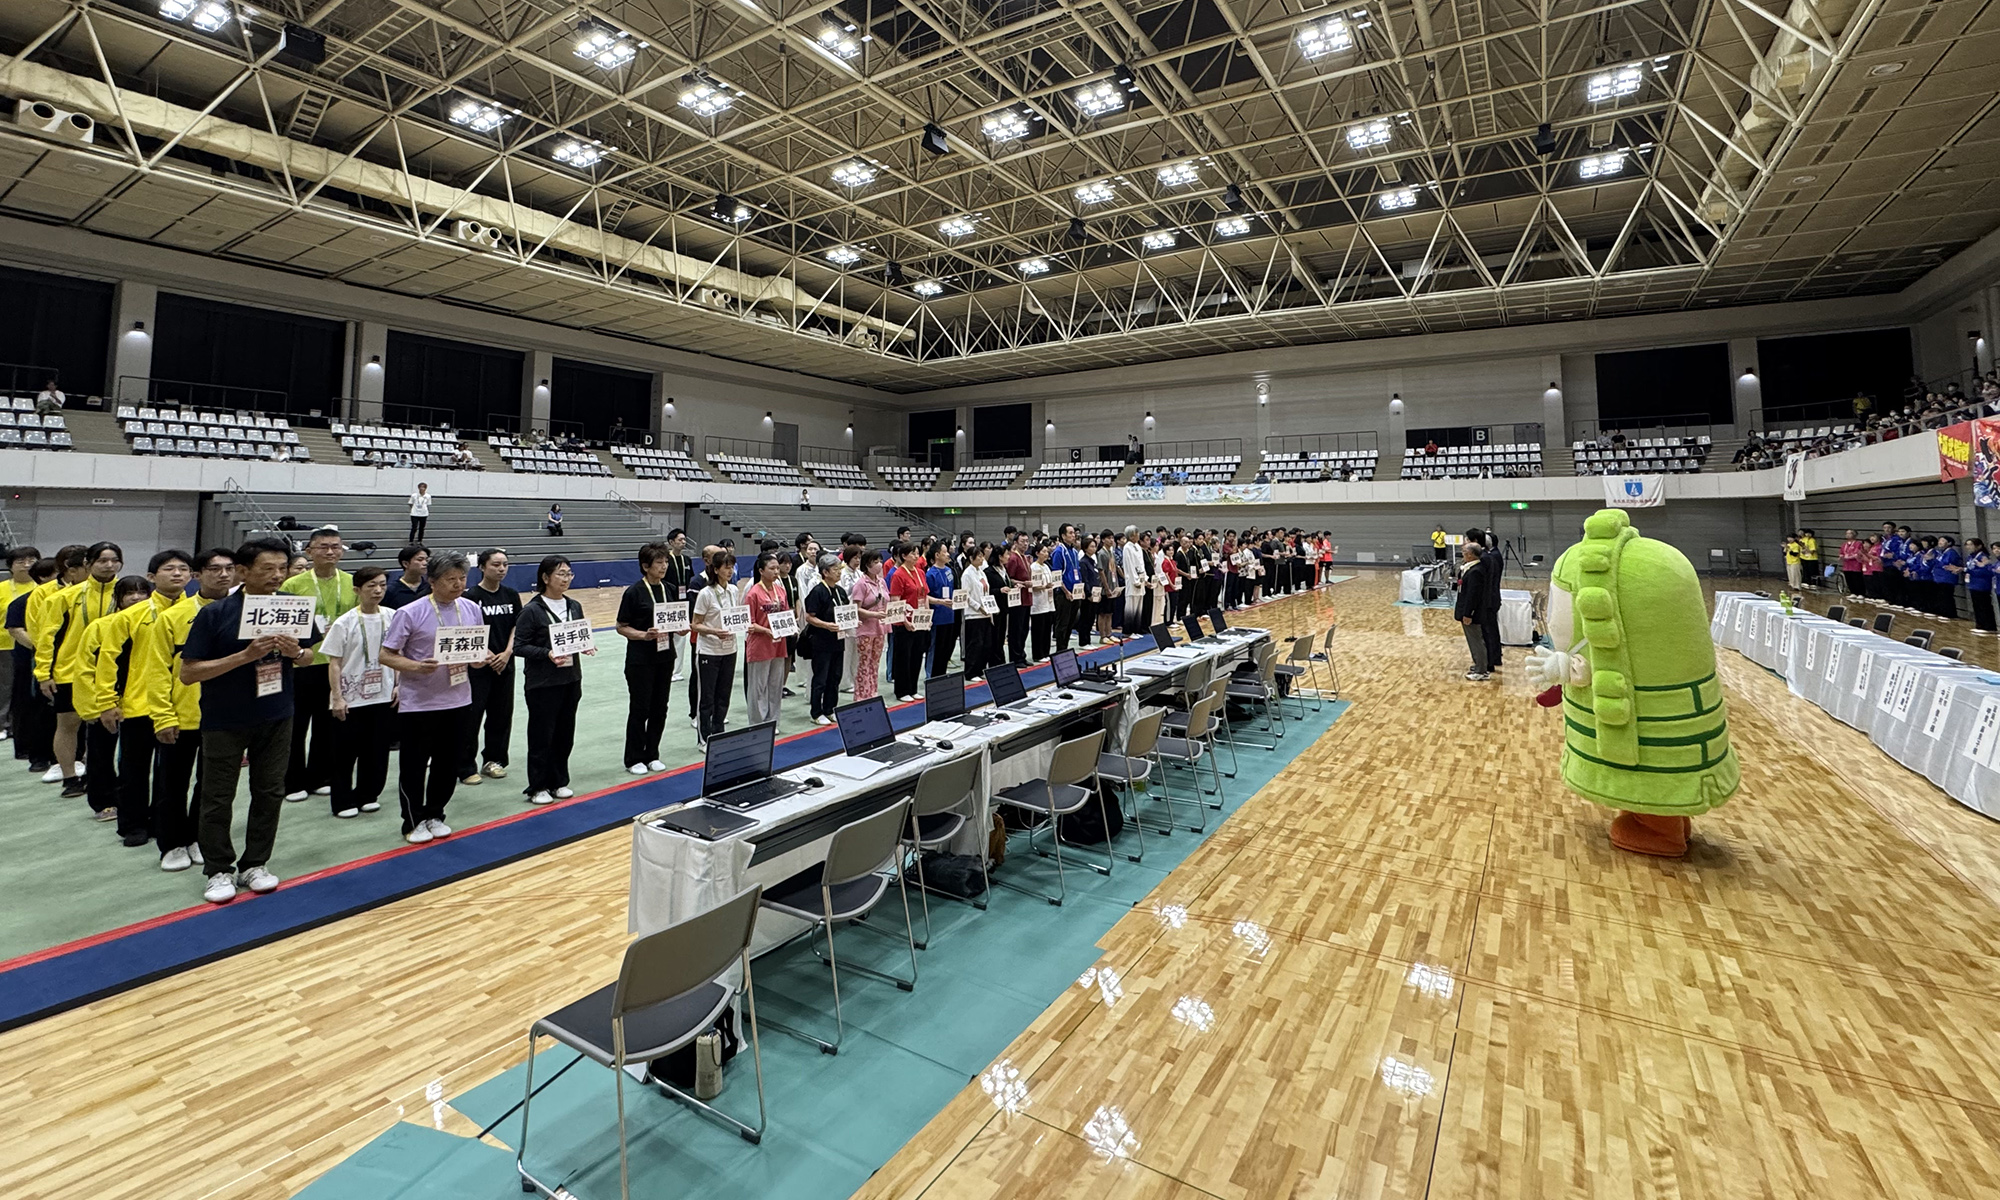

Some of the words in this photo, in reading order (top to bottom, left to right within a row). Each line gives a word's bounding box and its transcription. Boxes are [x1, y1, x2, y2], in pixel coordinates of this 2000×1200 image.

[645, 434, 653, 445] D
[1476, 430, 1486, 441] B
[1072, 450, 1080, 459] C
[246, 608, 311, 626] 北海道
[656, 611, 687, 624] 宮城県
[723, 613, 750, 626] 秋田県
[836, 610, 857, 622] 茨城県
[772, 617, 795, 629] 福島県
[554, 628, 591, 646] 岩手県
[438, 636, 485, 653] 青森県
